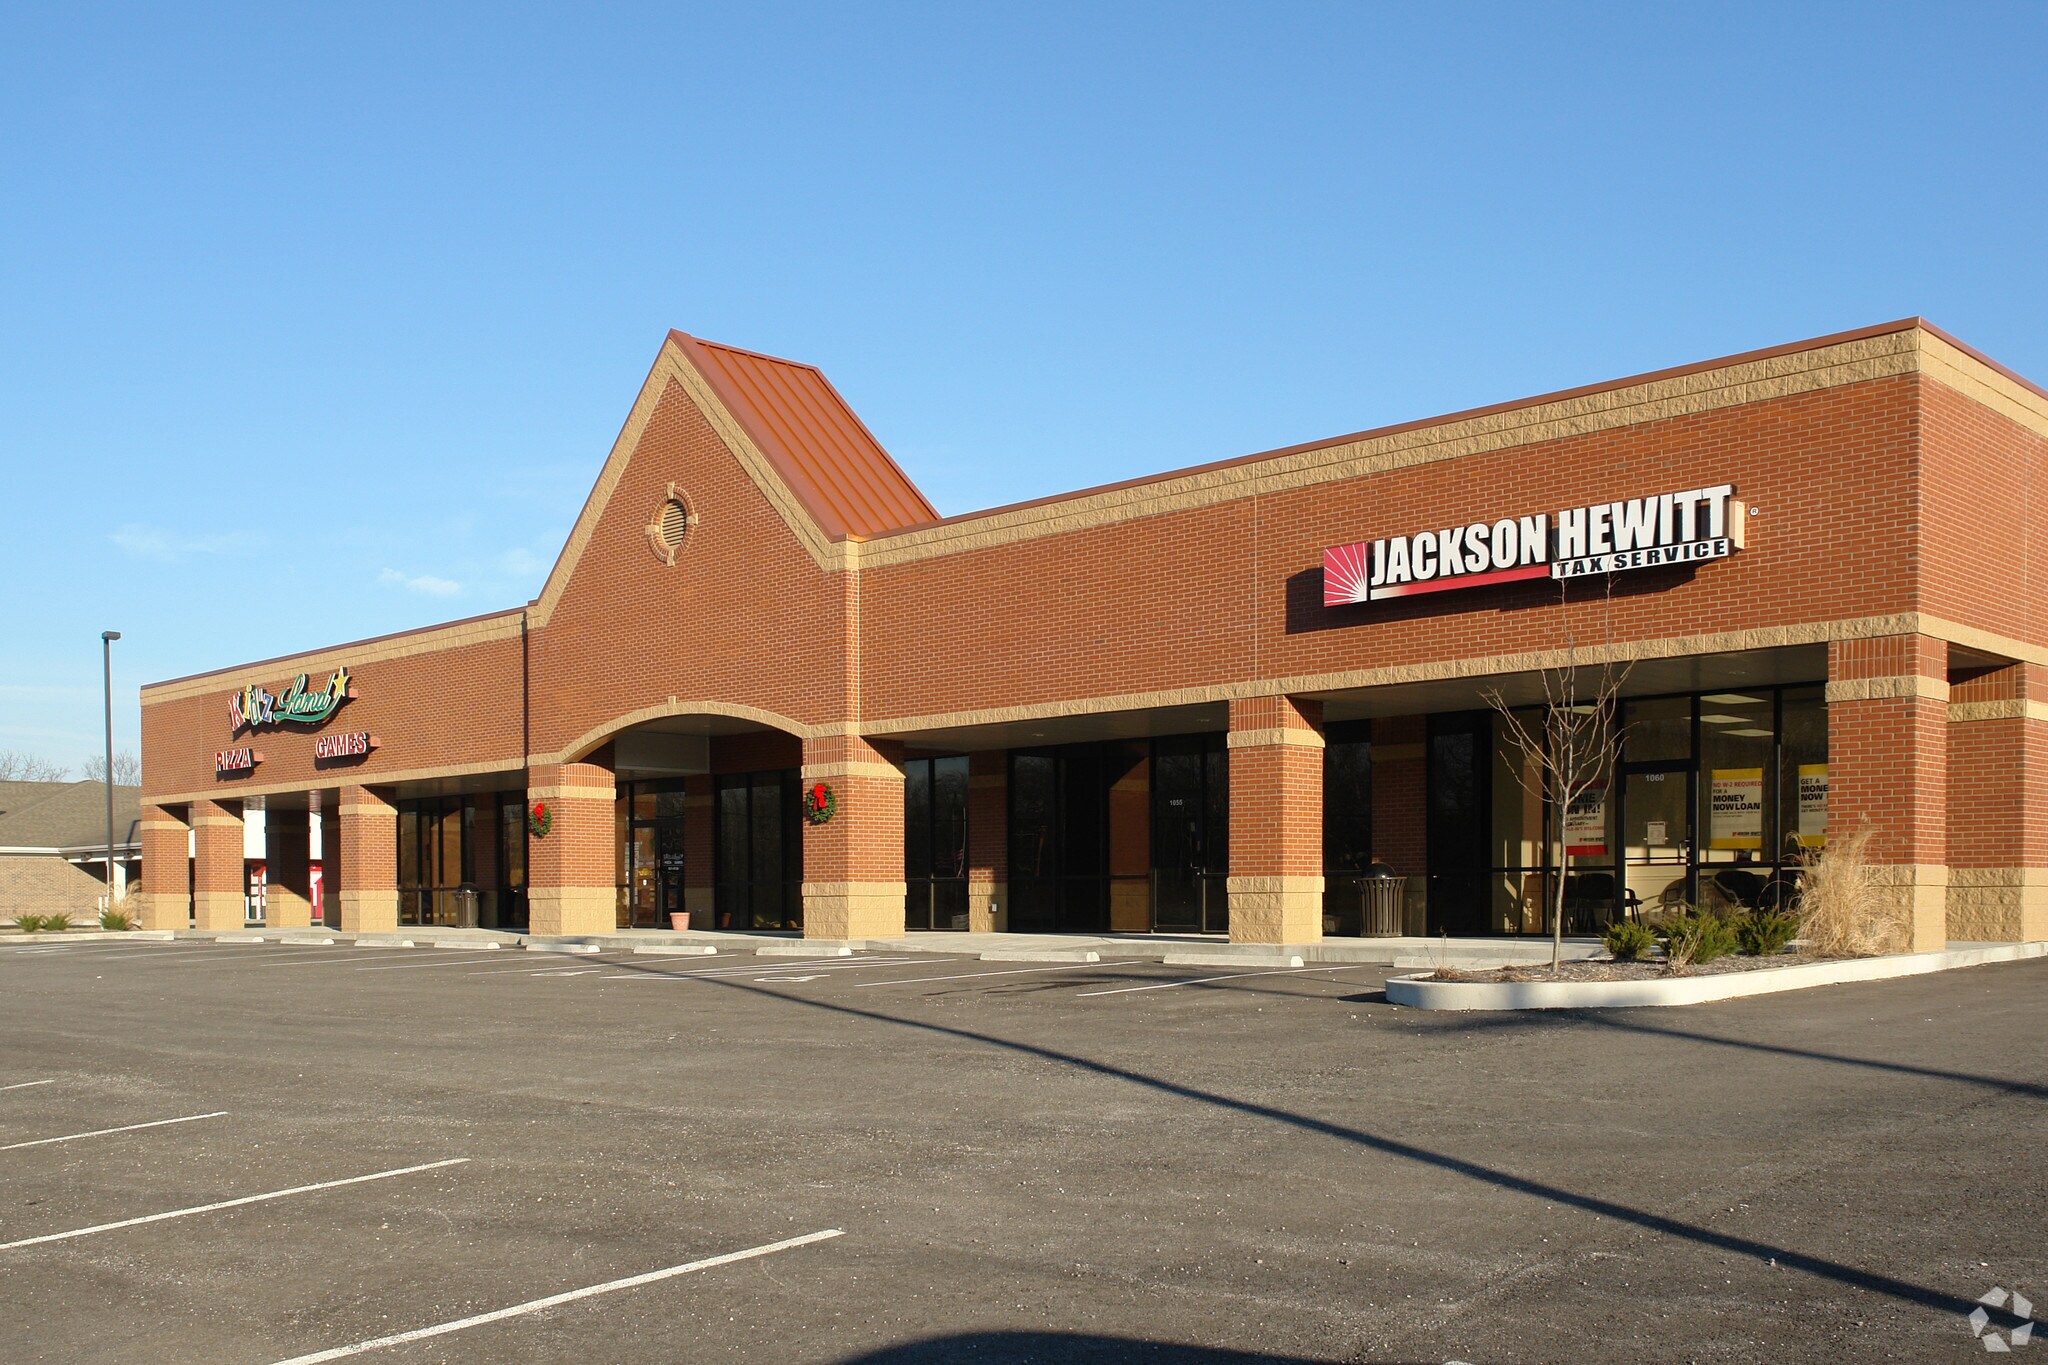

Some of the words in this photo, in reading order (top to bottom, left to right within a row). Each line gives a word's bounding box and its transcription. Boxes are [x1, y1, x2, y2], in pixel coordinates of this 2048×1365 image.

[1370, 514, 1548, 586] JACKSON
[1558, 485, 1732, 559] HEWITT
[1556, 555, 1603, 577] TAX
[1613, 540, 1727, 568] SERVICE
[278, 672, 336, 714] Land
[316, 732, 367, 759] GAMES
[215, 747, 252, 772] PIZZA
[1645, 774, 1665, 782] 1060
[1800, 785, 1828, 793] MONE
[1712, 803, 1734, 811] NOW
[1800, 793, 1823, 801] NOW
